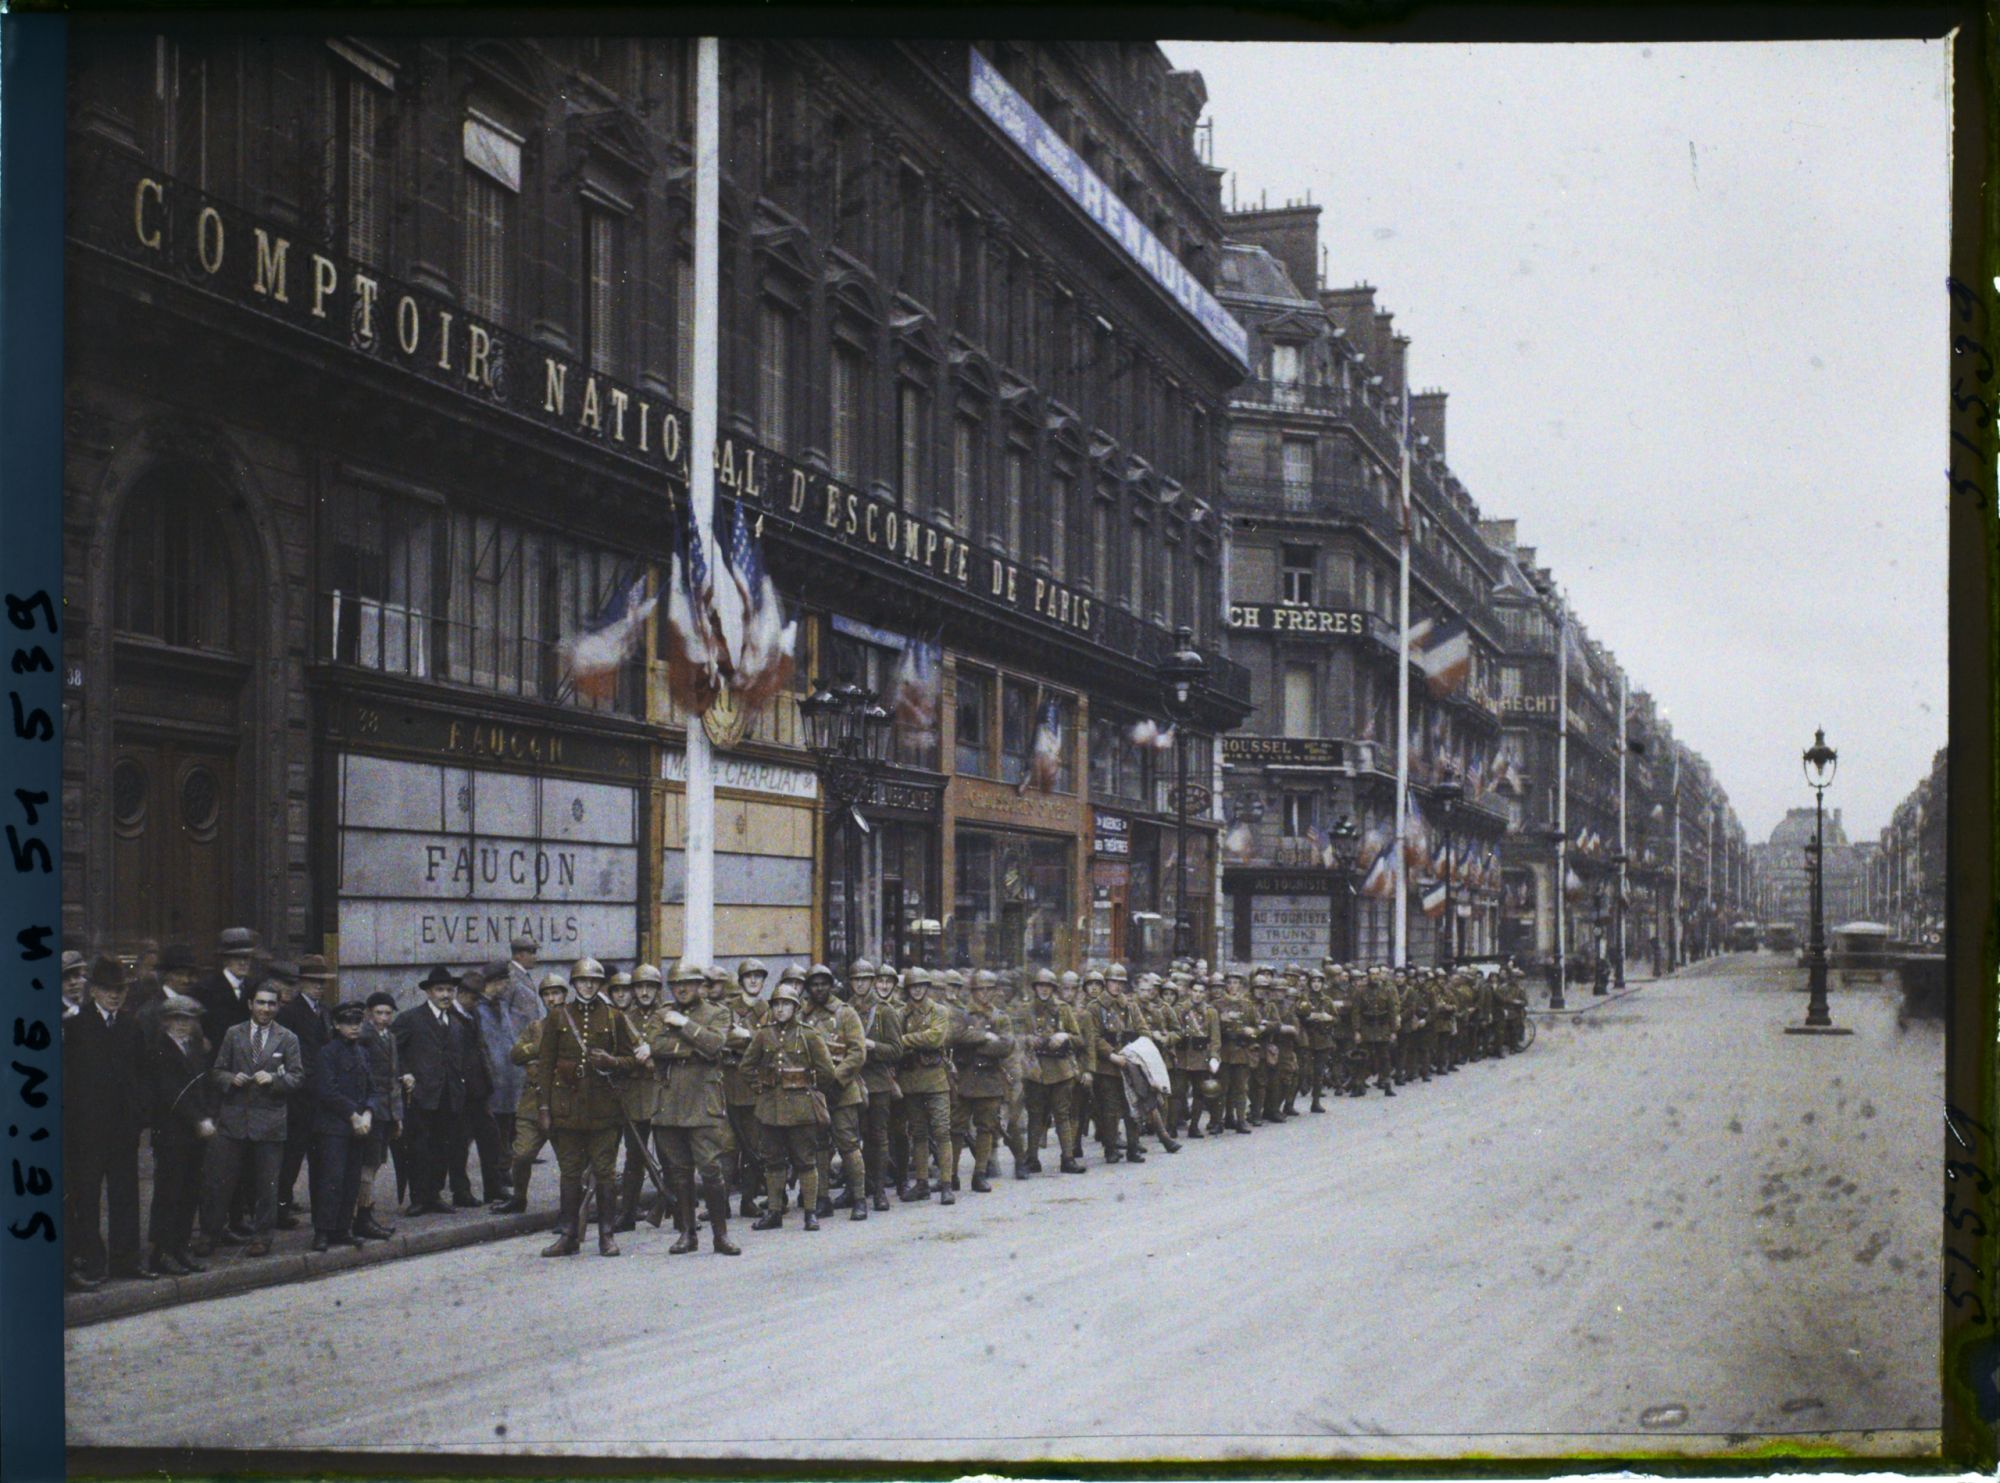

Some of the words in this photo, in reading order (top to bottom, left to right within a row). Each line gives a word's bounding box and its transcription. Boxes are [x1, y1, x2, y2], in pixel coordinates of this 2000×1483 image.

[134, 177, 492, 388] COMPTOIR
[545, 358, 760, 497] NATIOAL
[790, 470, 969, 581] D'ESCOMPTE
[991, 559, 1017, 602] DE
[1034, 578, 1092, 631] PARIS
[66, 667, 82, 686] 38
[448, 720, 563, 762] FAUCON
[425, 845, 576, 886] FAUCON
[422, 915, 577, 945] EVENTAILS
